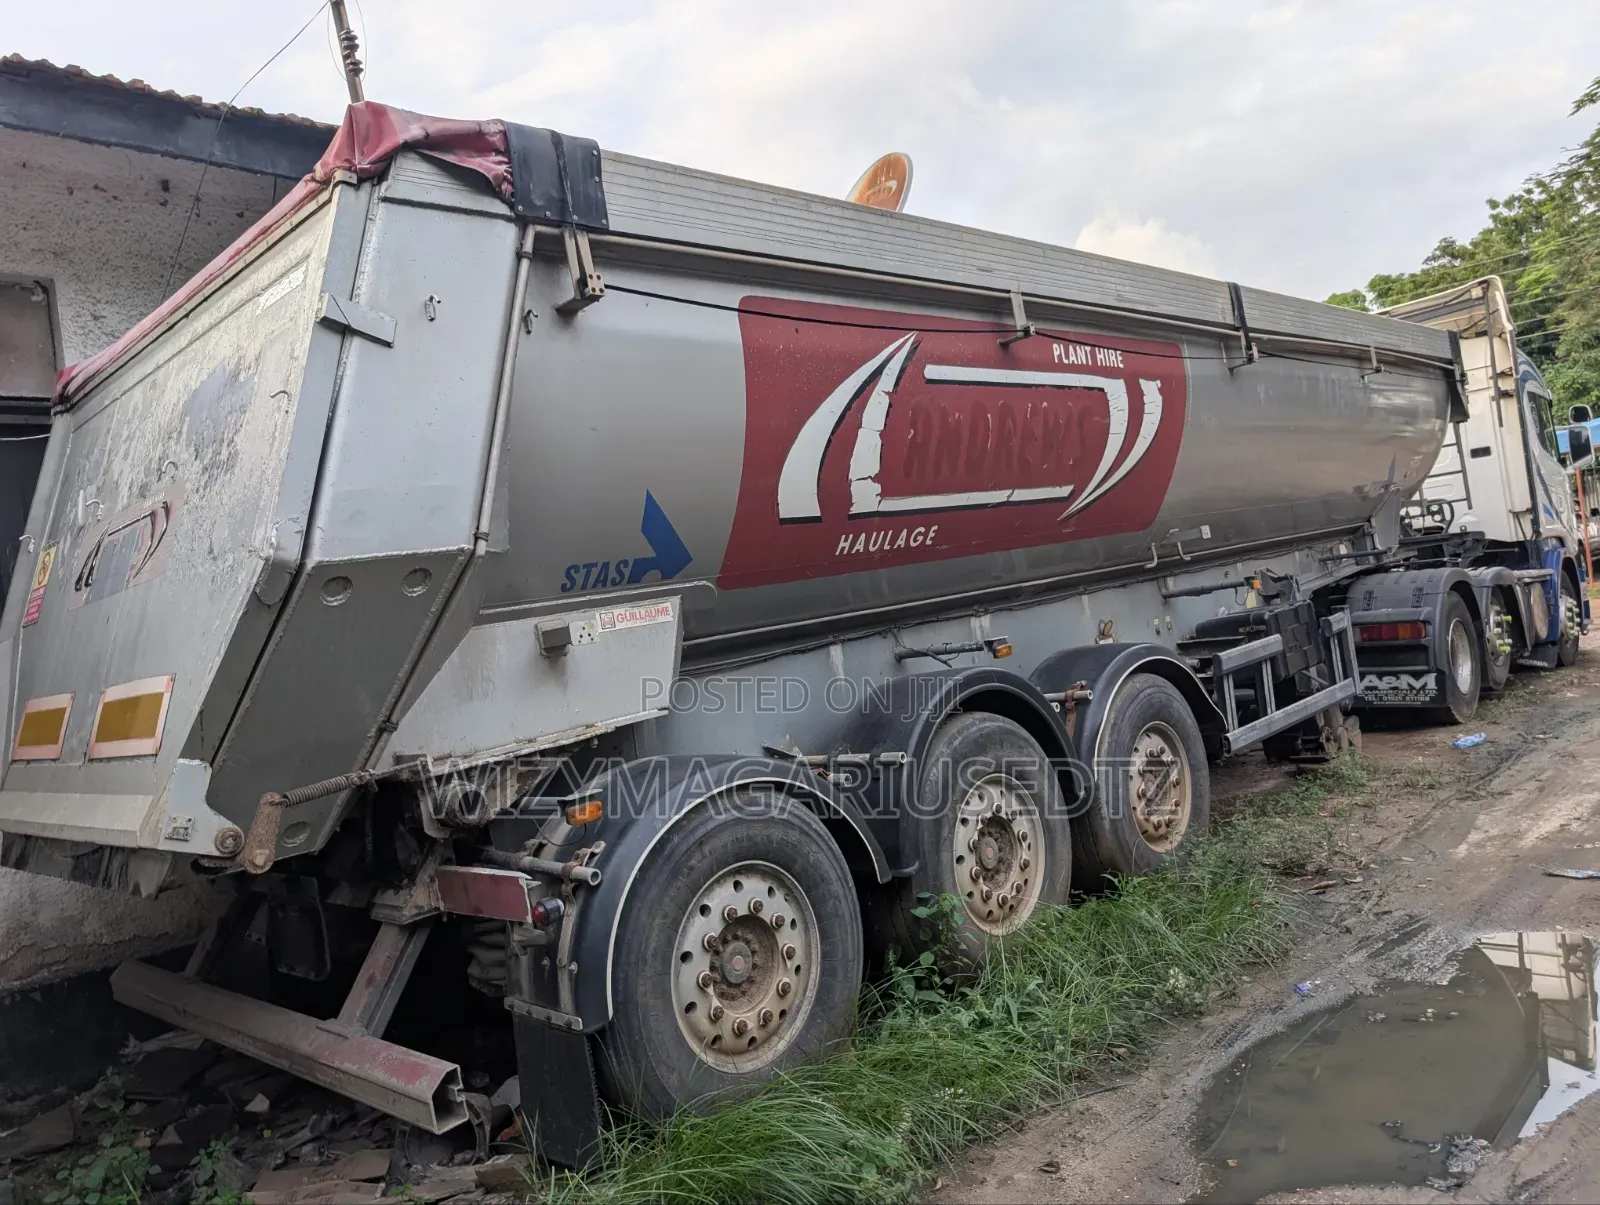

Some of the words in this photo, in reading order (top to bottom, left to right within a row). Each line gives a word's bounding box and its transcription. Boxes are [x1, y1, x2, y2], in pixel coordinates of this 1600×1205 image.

[1052, 343, 1092, 365] PLANT
[1095, 347, 1124, 368] HIRE
[835, 525, 939, 556] HAULAGE
[560, 558, 630, 593] STAS
[616, 606, 671, 623] GUILLAUME
[1360, 672, 1438, 690] A&M
